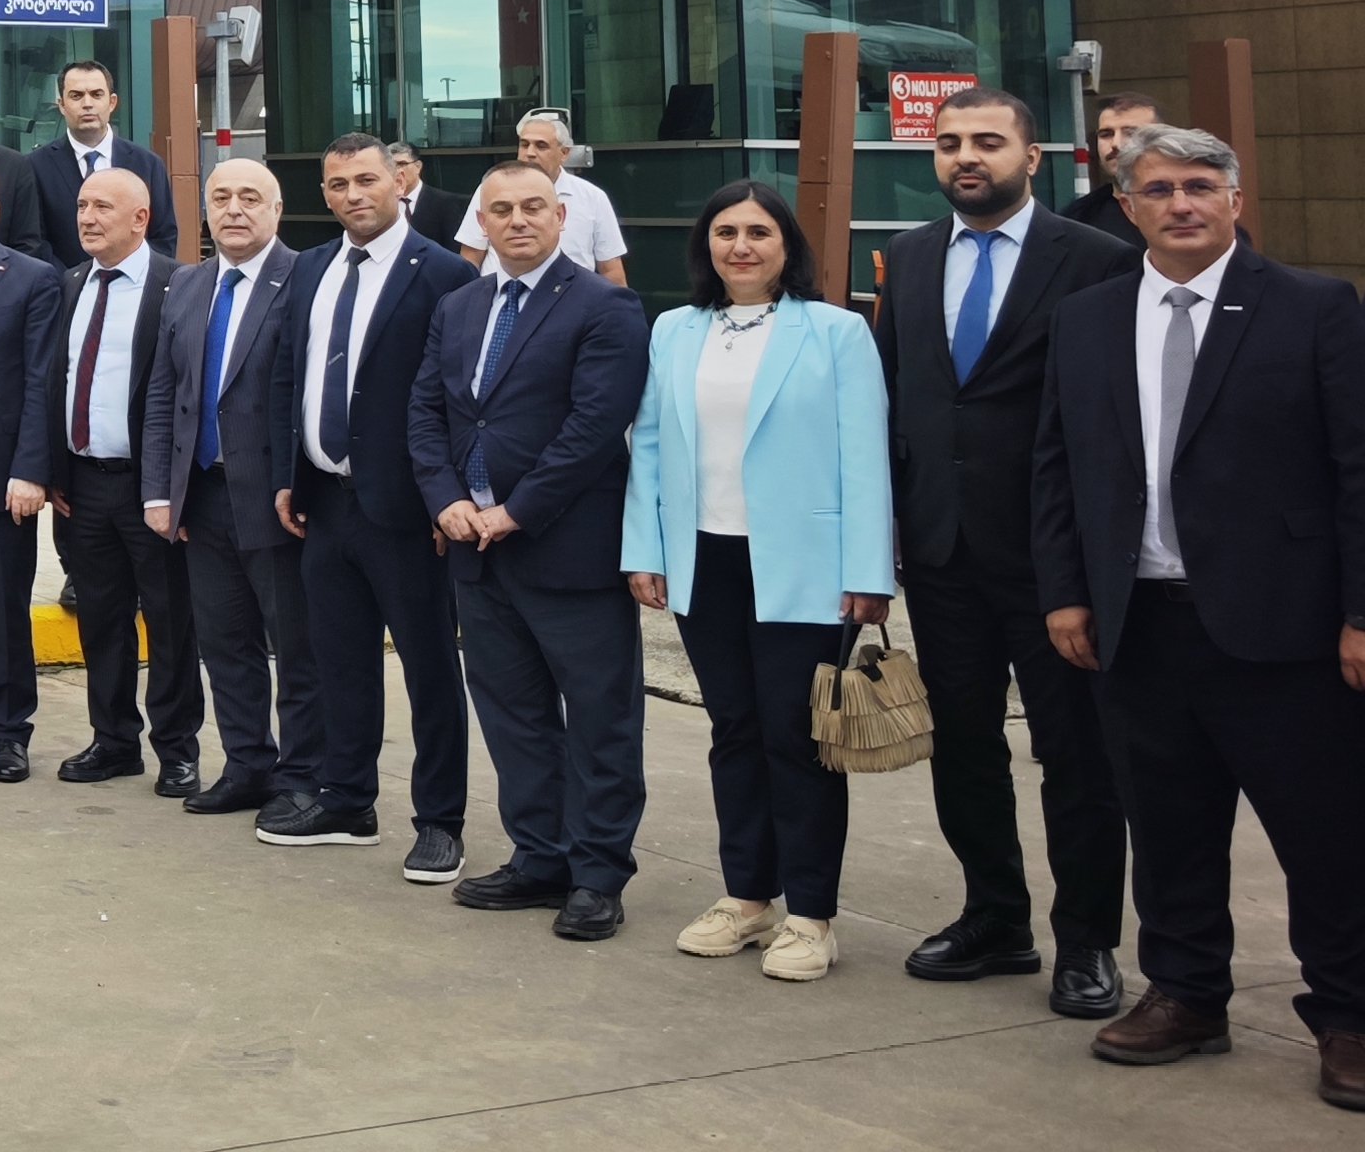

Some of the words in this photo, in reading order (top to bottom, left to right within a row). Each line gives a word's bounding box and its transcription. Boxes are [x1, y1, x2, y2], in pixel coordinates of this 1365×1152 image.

[911, 80, 939, 97] NOLU
[903, 101, 935, 118] BOŞ
[895, 126, 930, 137] EMPTY
